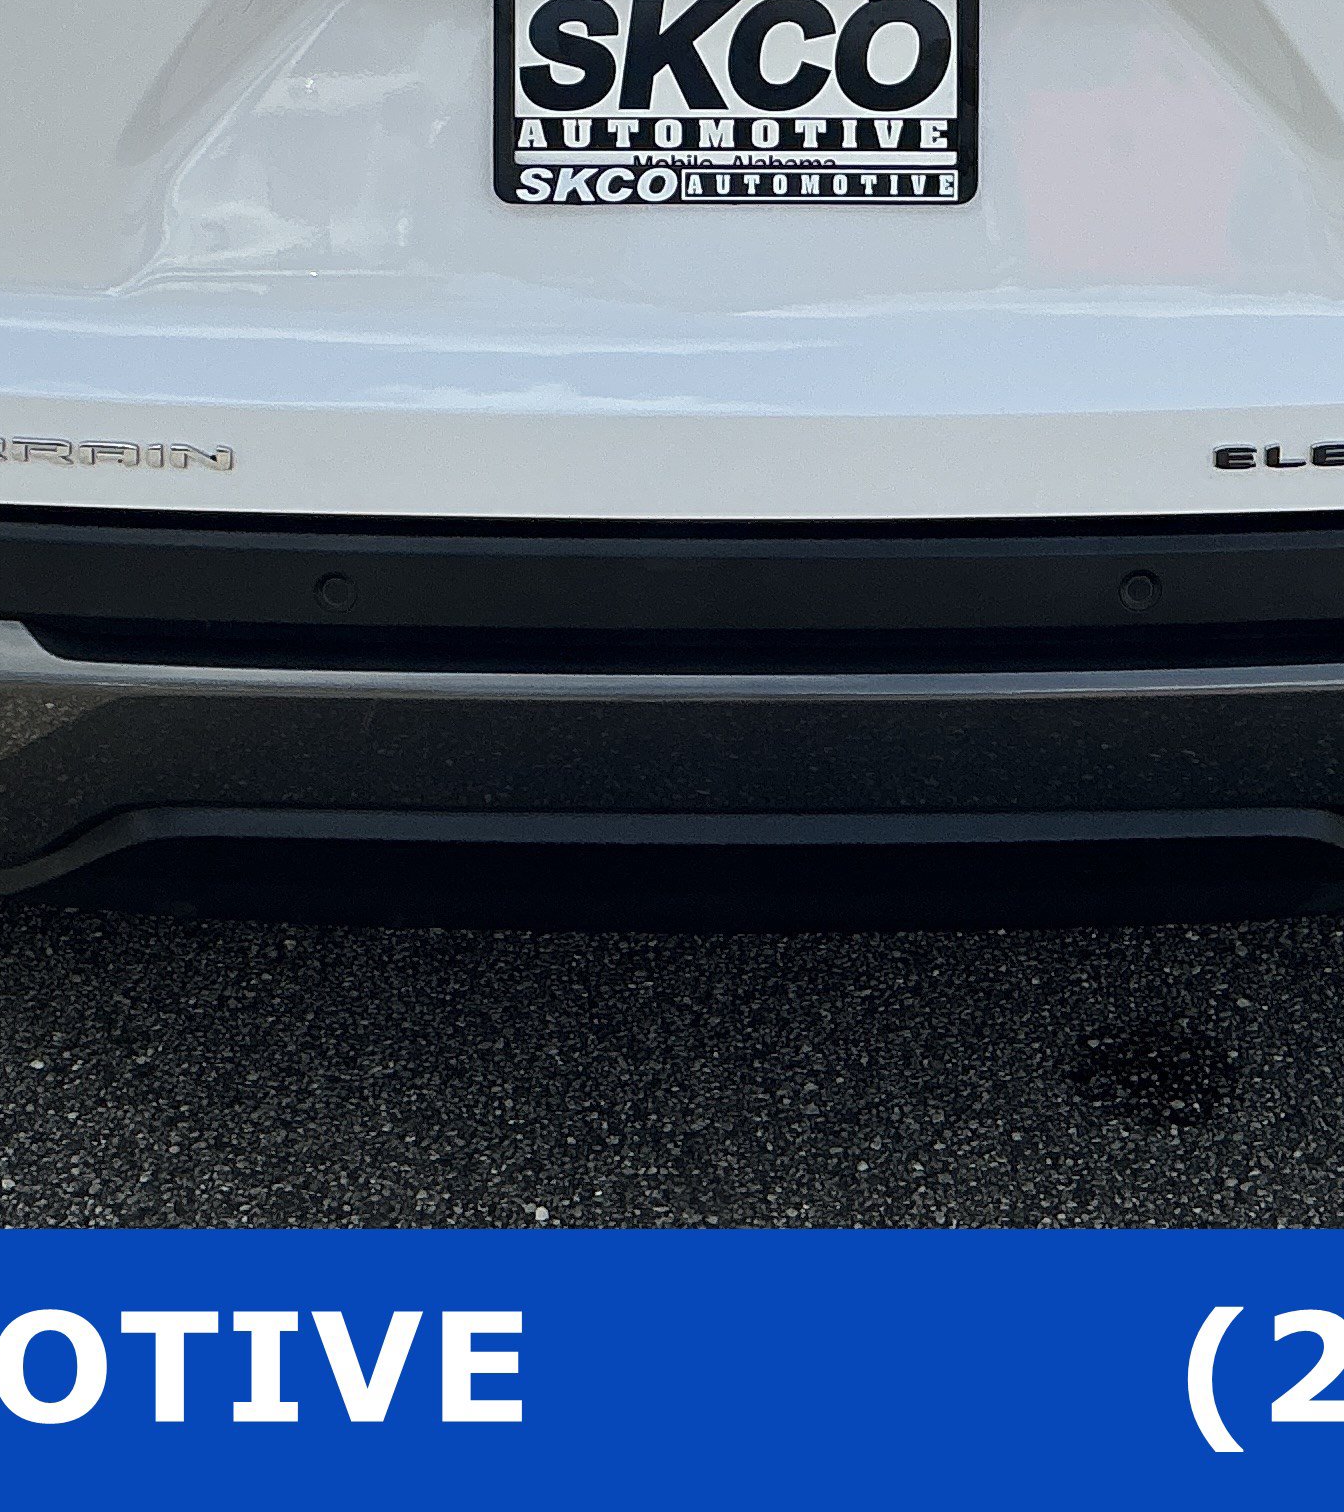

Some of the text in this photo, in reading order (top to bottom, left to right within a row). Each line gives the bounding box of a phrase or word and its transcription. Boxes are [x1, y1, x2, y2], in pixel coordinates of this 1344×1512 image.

[519, 119, 949, 149] AUTOMOTIVE
[516, 167, 955, 202] SKCO AUTOMOTIVE
